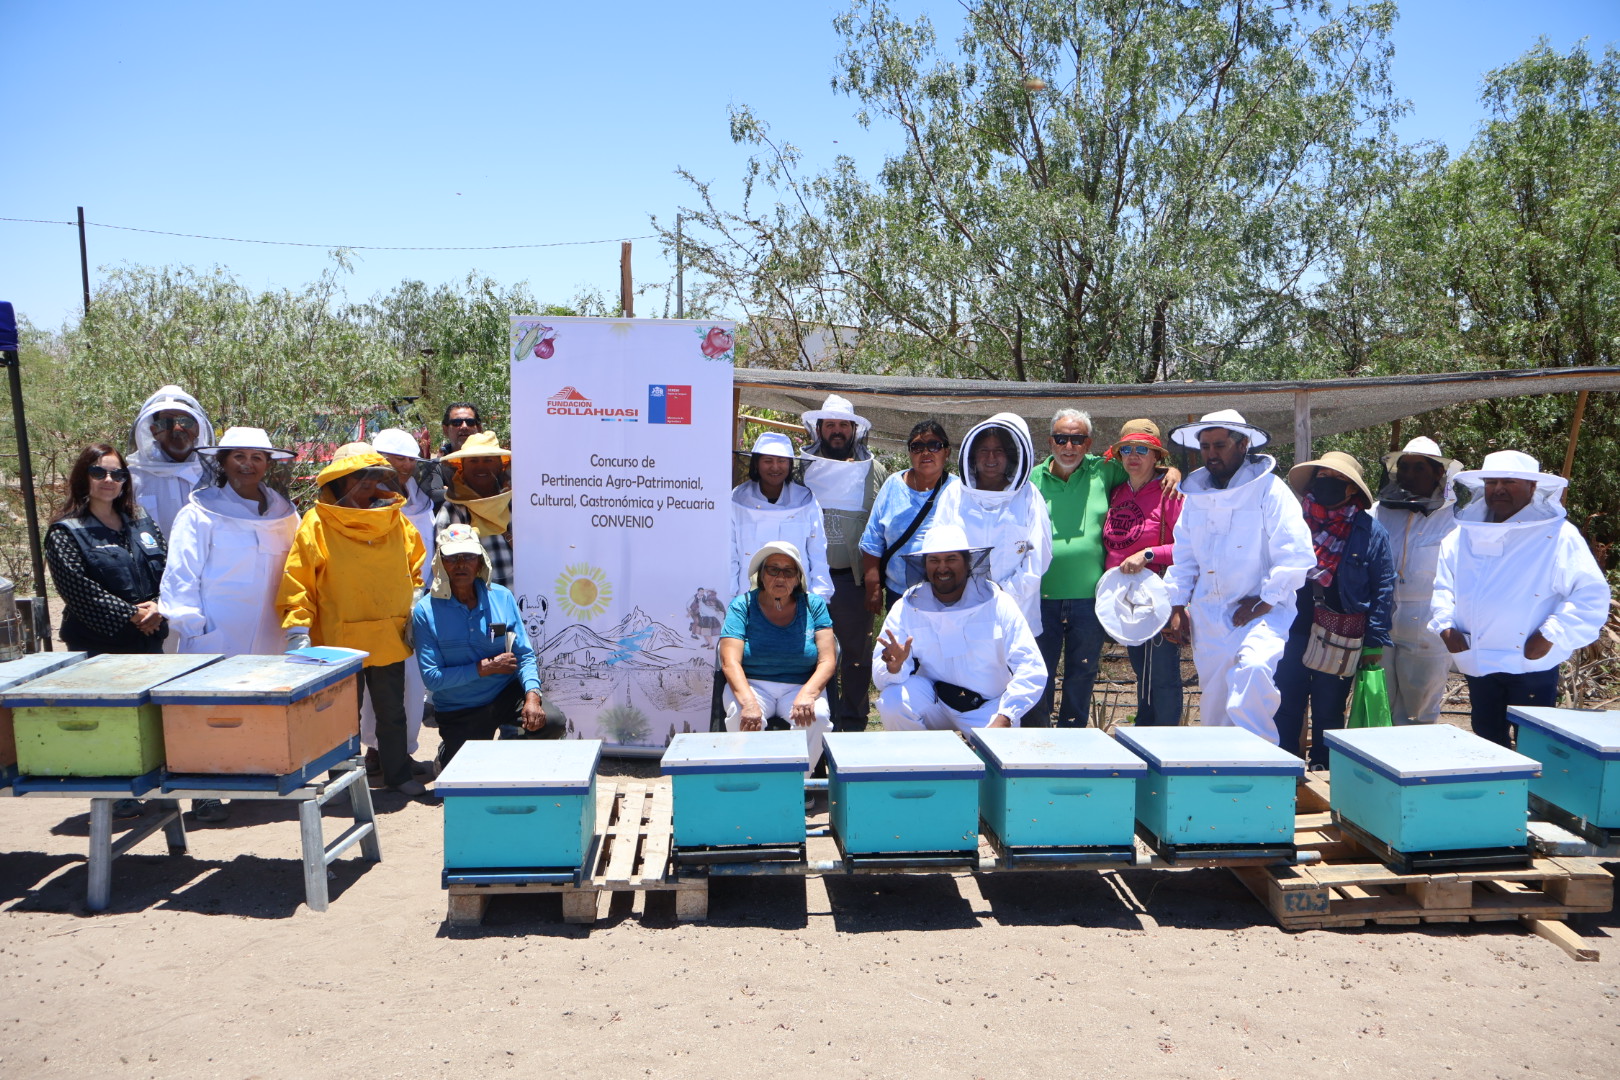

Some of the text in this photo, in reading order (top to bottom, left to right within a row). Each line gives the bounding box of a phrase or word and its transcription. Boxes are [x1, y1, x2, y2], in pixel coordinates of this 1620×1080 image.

[547, 400, 592, 408] FUNDACIÓN
[547, 407, 639, 417] COLLAHUASI
[590, 453, 656, 468] Concurso de
[541, 473, 704, 491] Pertinencia Agro-Patrimonial,
[530, 492, 715, 512] Cultural, Gastronómica y Pecuaria
[591, 514, 654, 529] CONVENIO
